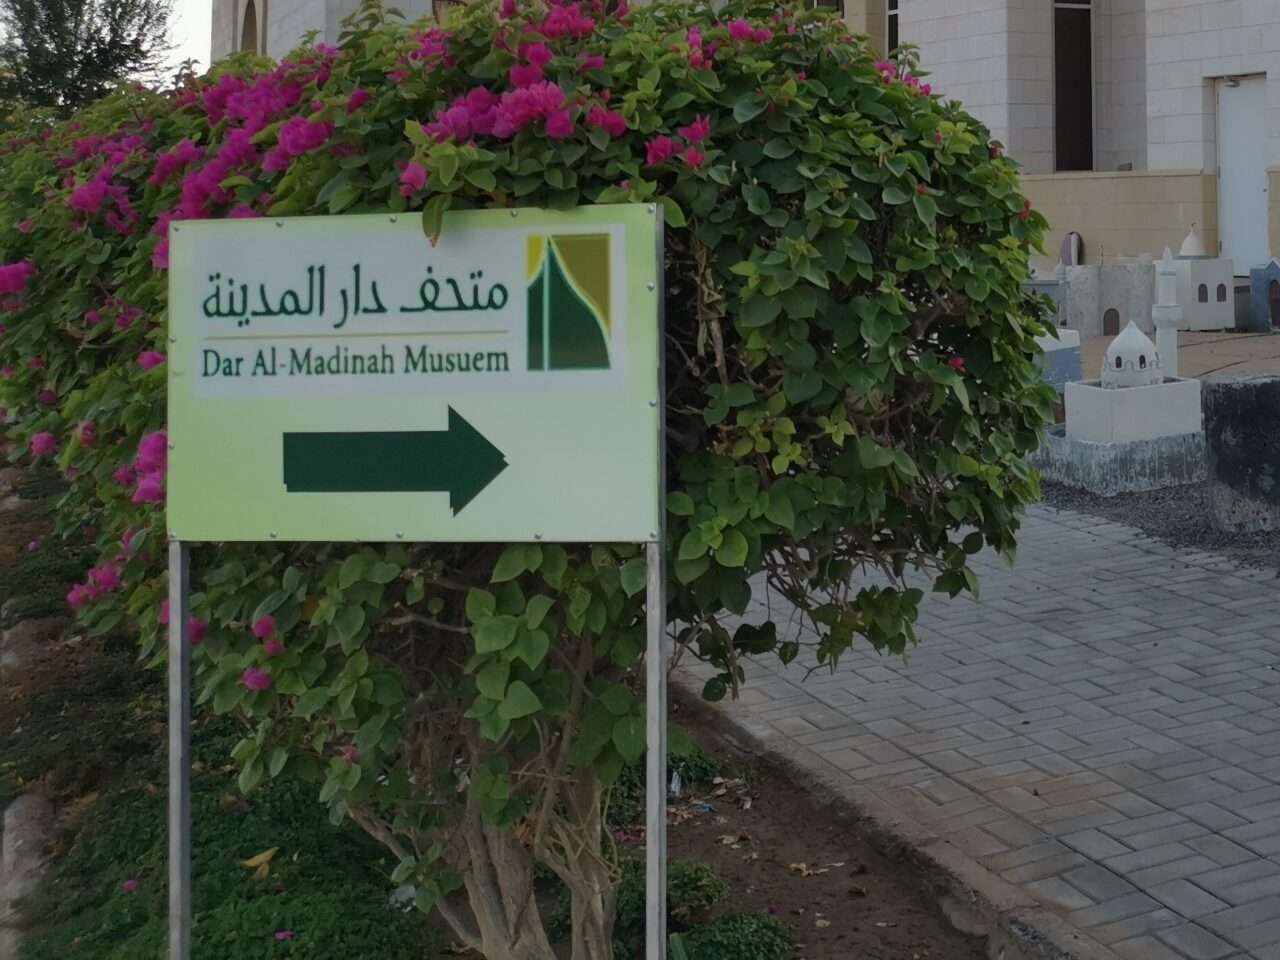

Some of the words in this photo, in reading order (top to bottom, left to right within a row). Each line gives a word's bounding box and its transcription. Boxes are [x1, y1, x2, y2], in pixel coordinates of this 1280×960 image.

[202, 265, 326, 328] المدينة
[333, 263, 389, 329] دار
[399, 268, 509, 314] متحف
[202, 348, 244, 377] Dar
[251, 344, 396, 377] Al-Madinah
[403, 345, 510, 374] Musuem
